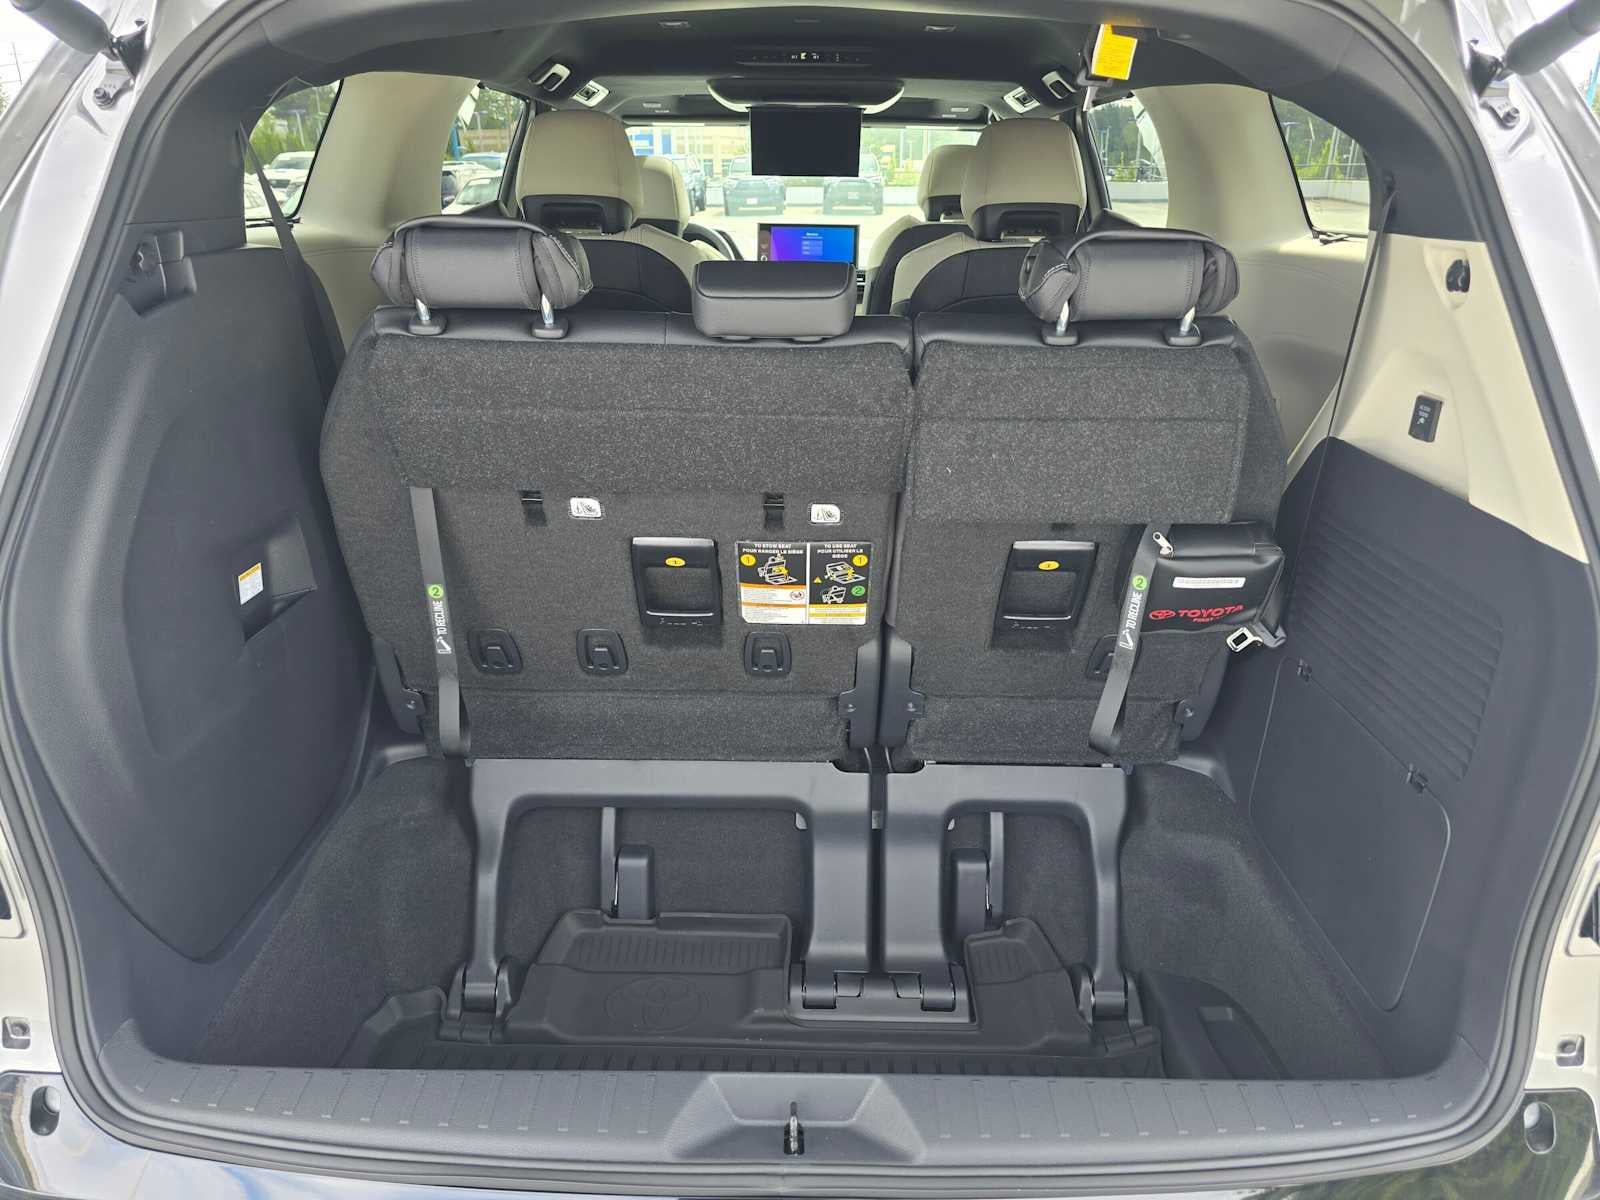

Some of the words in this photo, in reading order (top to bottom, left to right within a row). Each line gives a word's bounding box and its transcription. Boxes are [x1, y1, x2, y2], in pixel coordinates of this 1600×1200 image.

[1128, 591, 1142, 621] RECLINE
[1178, 604, 1244, 618] TOYOTA
[432, 600, 446, 627] RECLINE
[436, 627, 447, 635] TO
[1126, 620, 1137, 630] TO
